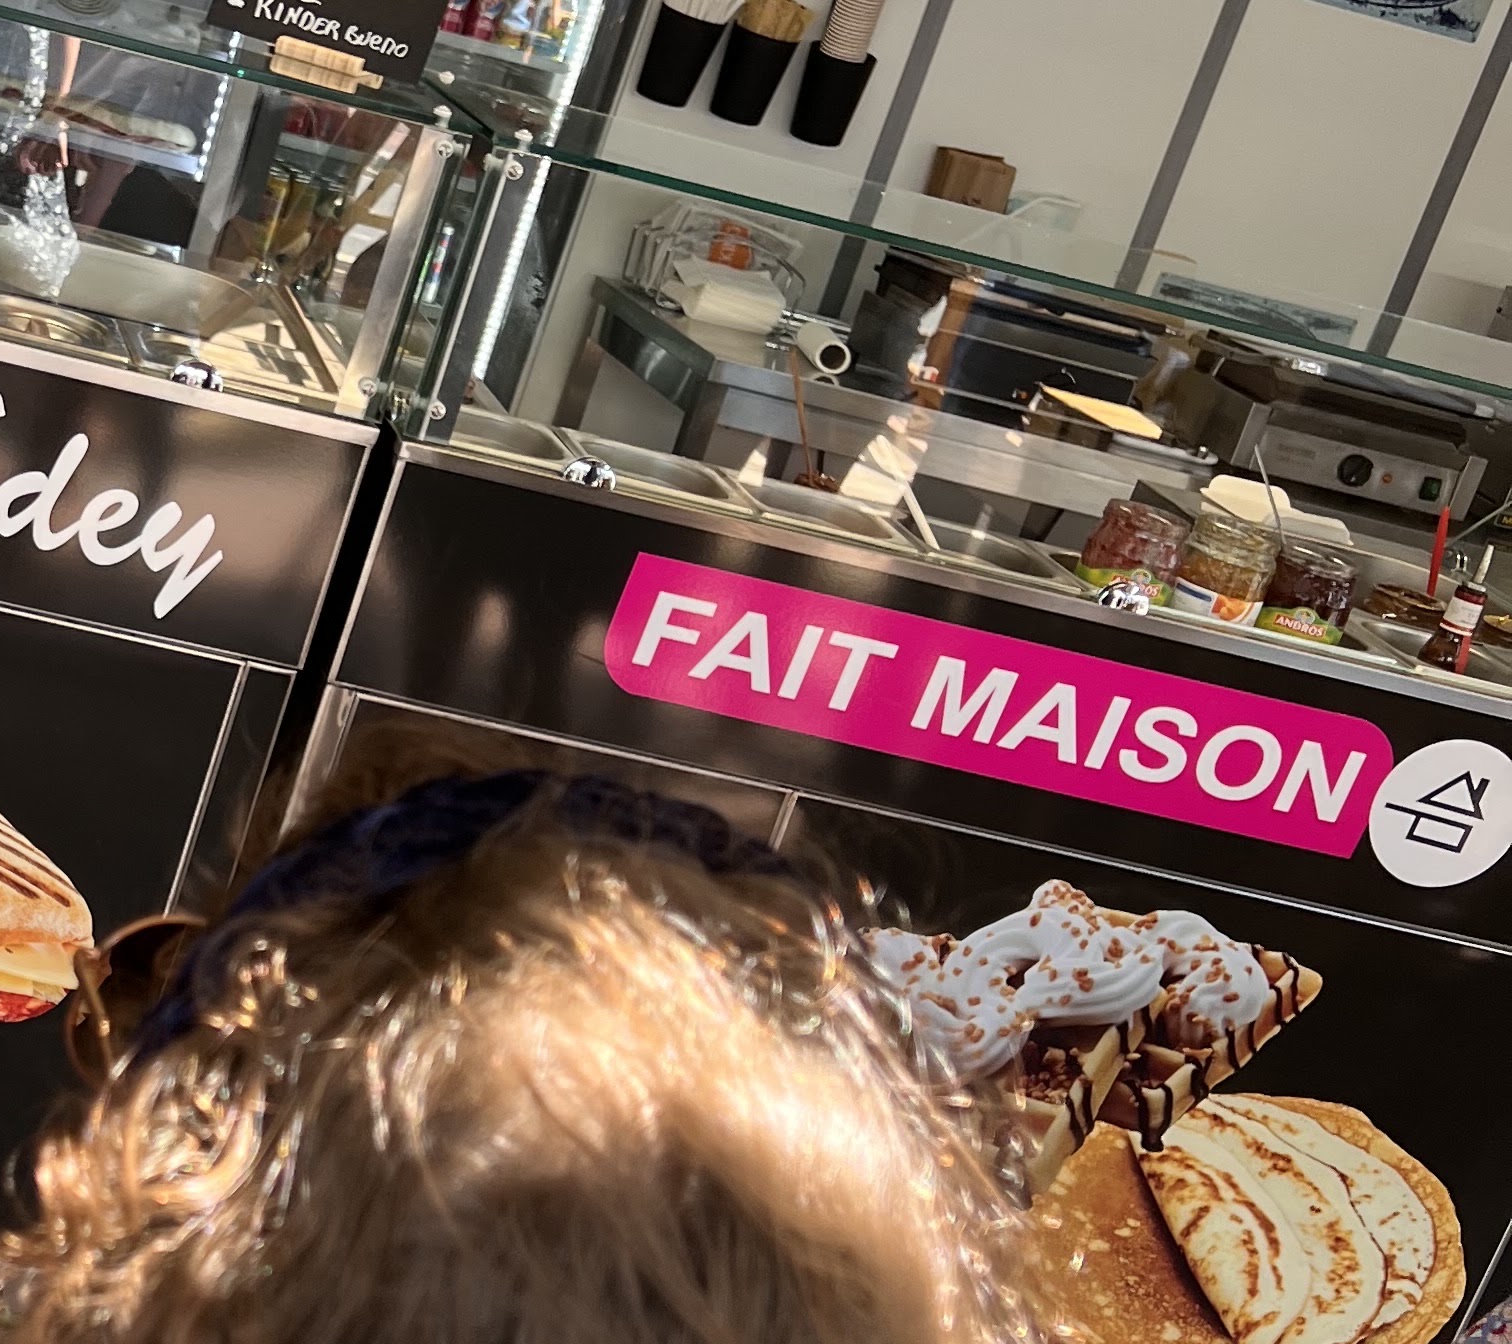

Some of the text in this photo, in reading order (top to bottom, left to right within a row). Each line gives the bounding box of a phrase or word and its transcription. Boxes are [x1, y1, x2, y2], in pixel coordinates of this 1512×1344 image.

[1111, 574, 1161, 598] AOS
[1276, 615, 1325, 638] ANDROS
[631, 591, 1367, 824] FAIT MAISON
